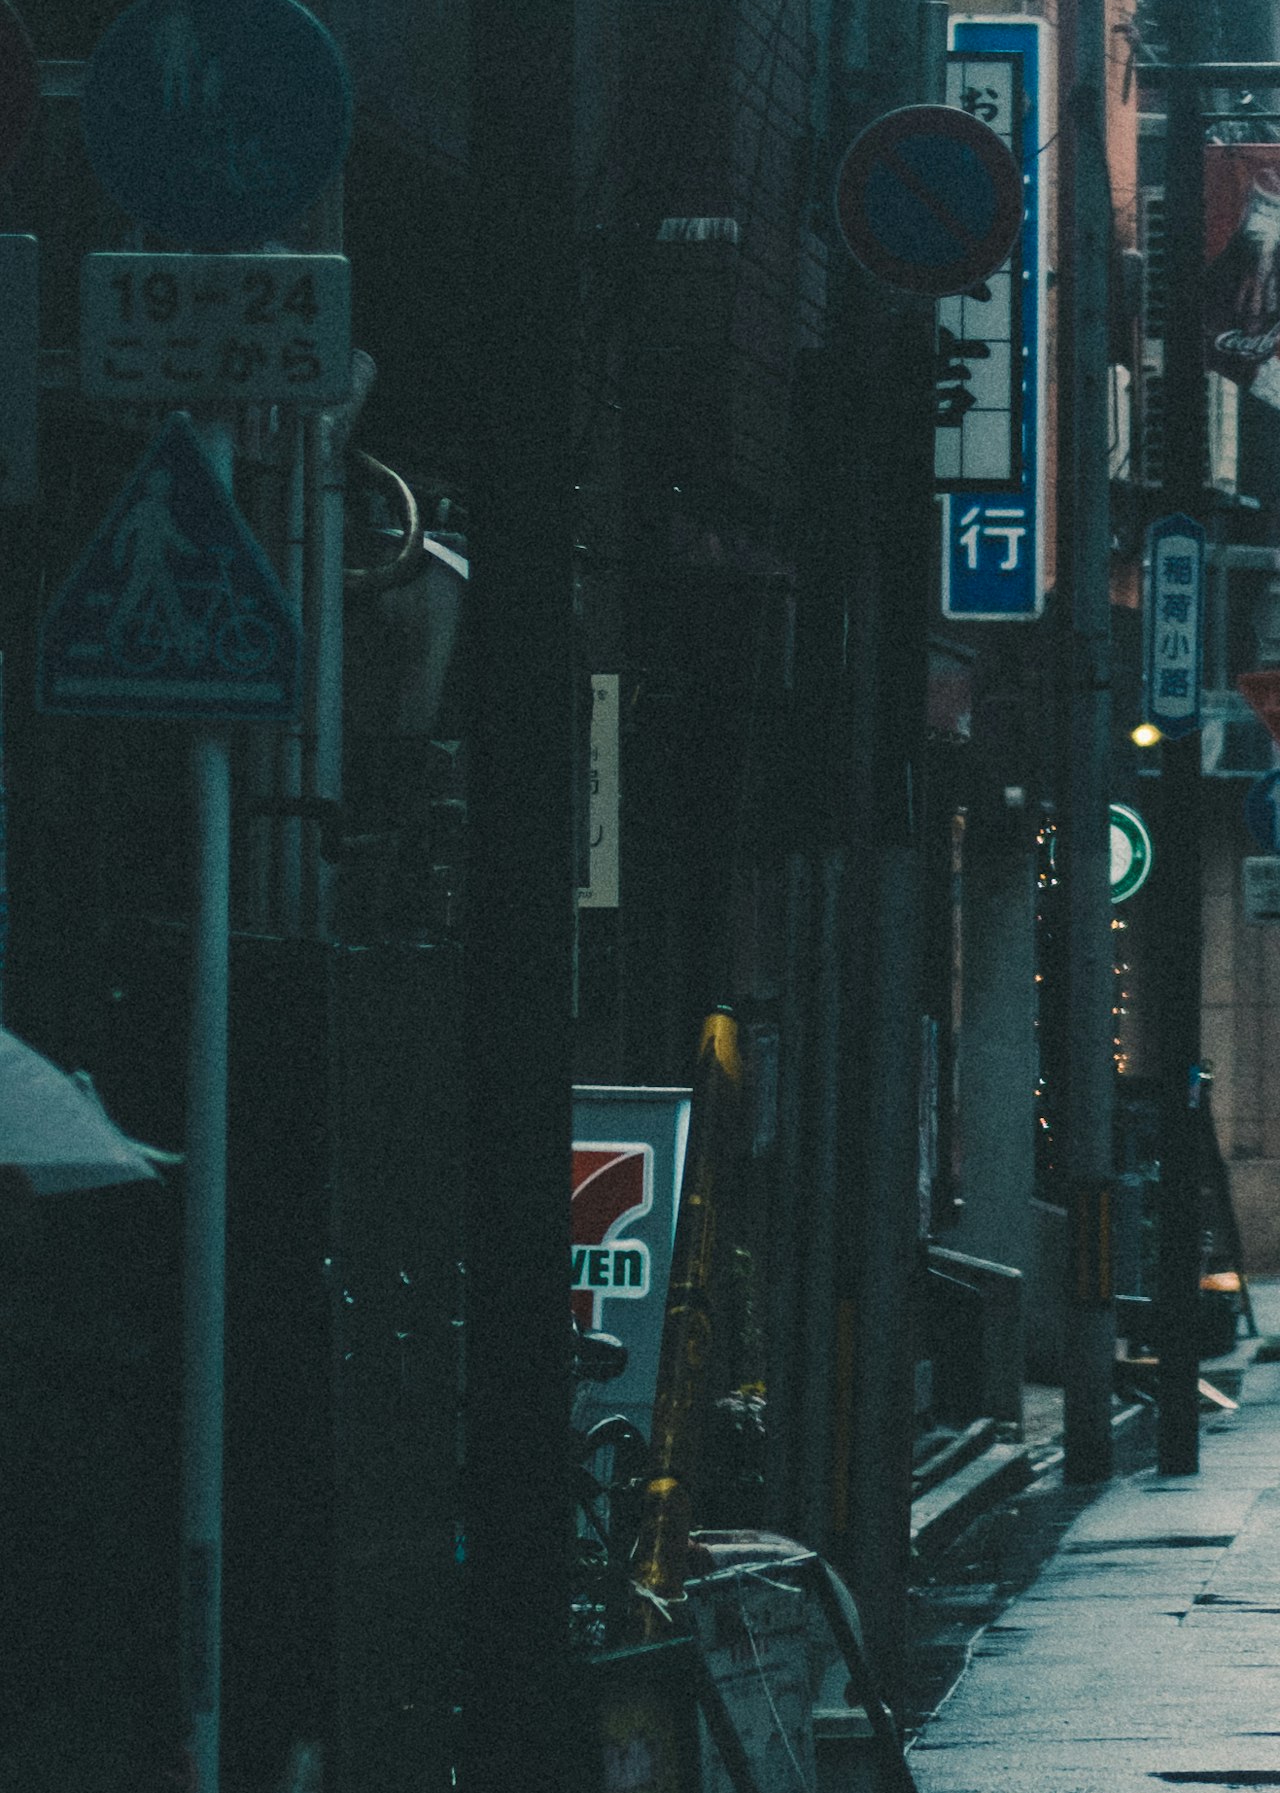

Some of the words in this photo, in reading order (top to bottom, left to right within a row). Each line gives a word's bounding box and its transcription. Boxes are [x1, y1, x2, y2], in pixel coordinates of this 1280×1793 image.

[102, 339, 321, 386] ここから
[1160, 555, 1193, 698] 稲荷小路
